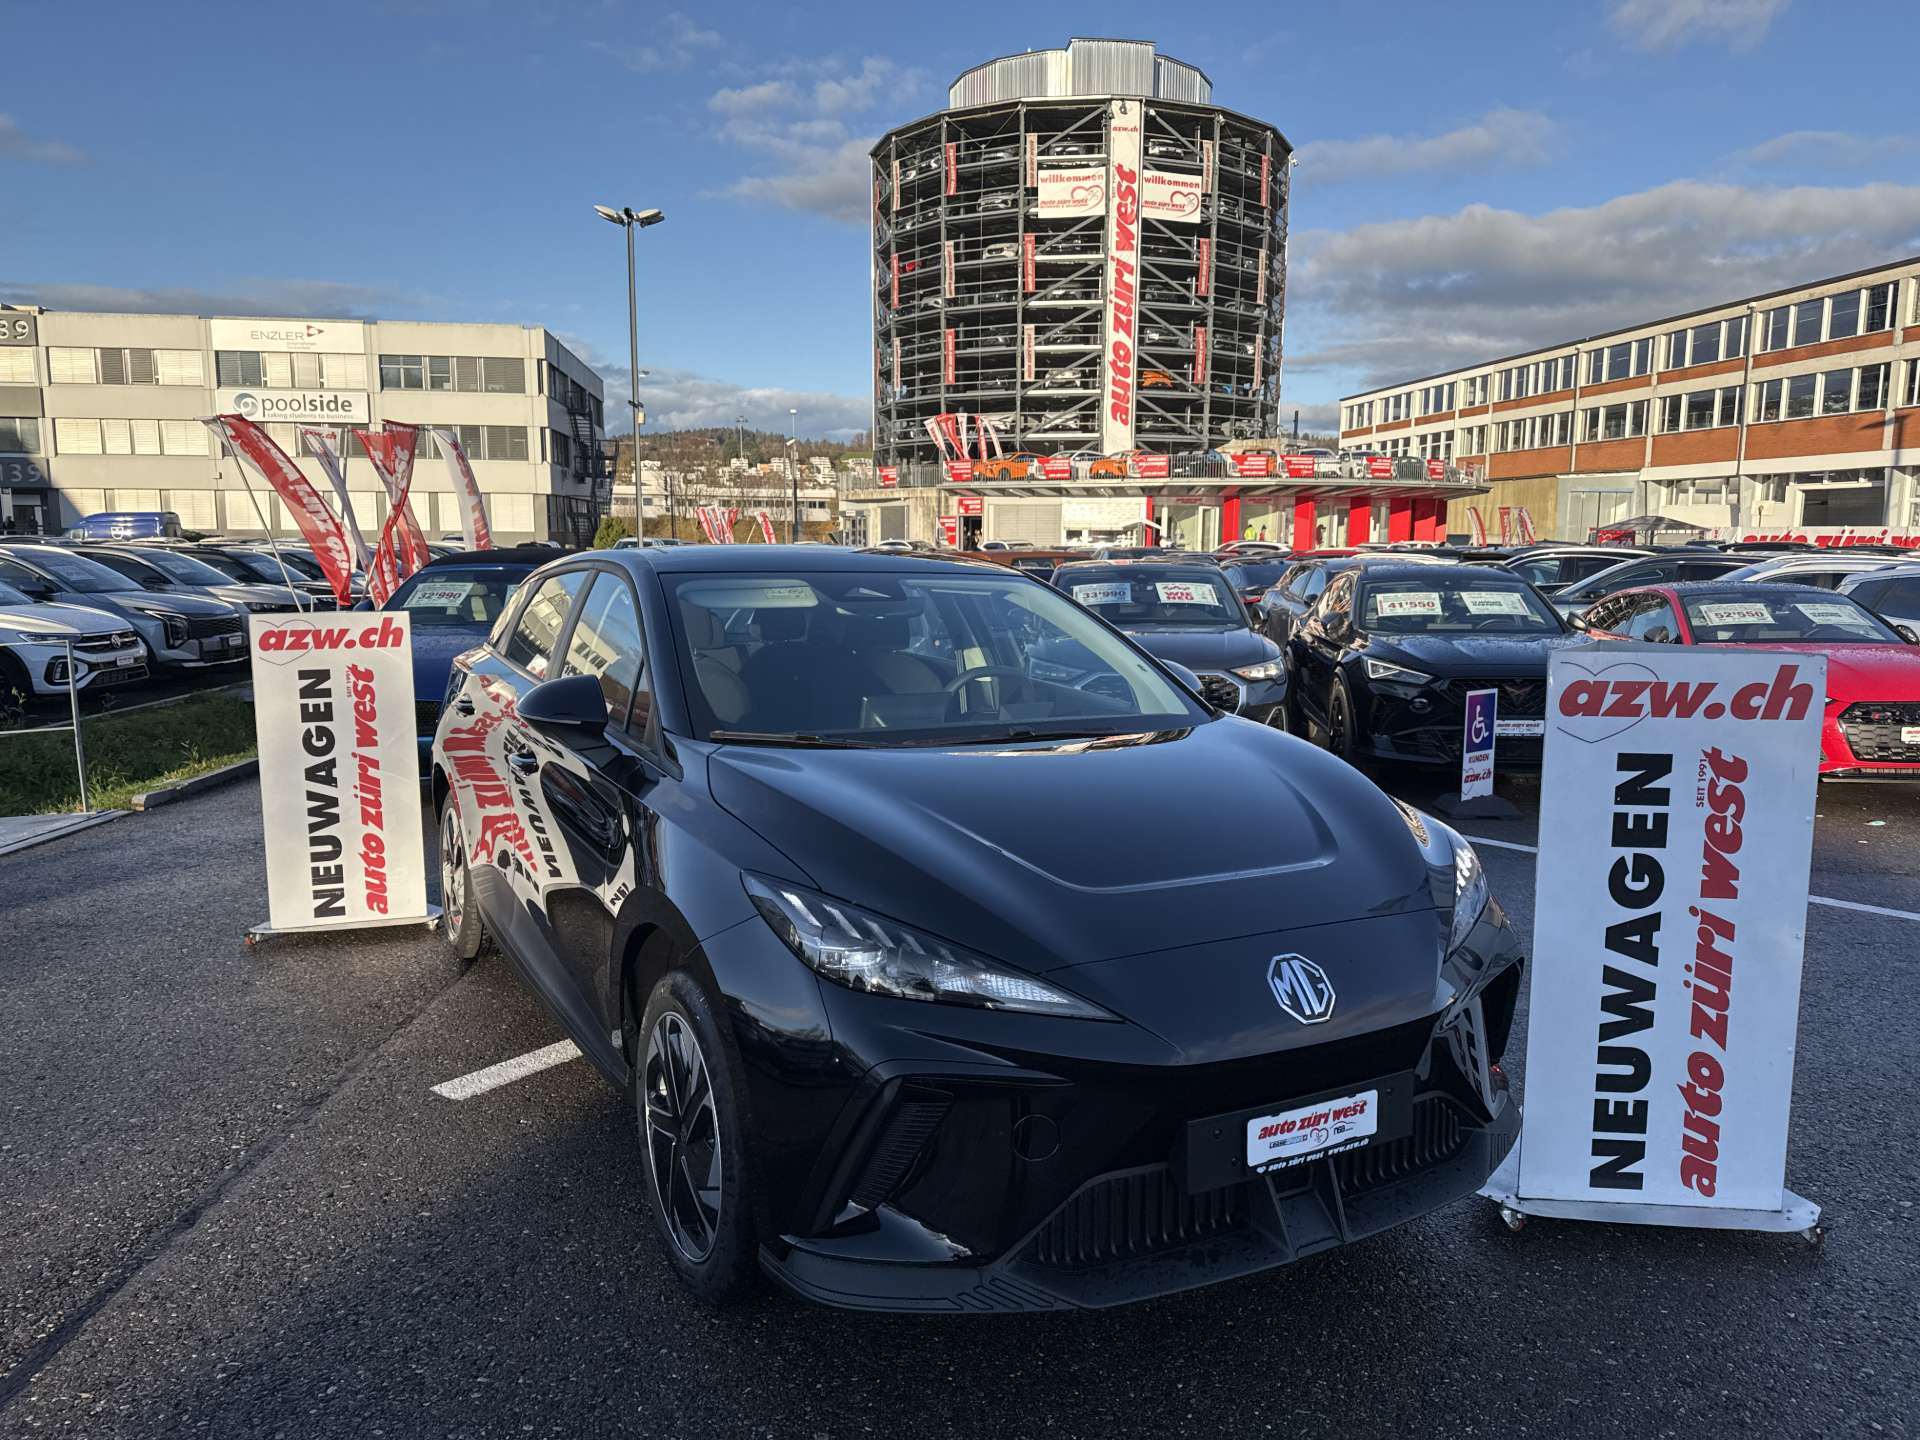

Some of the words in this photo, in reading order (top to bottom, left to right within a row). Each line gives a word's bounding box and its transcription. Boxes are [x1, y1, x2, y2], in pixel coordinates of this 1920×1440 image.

[1040, 173, 1103, 184] willkommen
[1143, 175, 1200, 189] willkommen
[1114, 163, 1137, 251] west
[1109, 256, 1135, 339] züri
[251, 330, 304, 341] ENZLER
[1108, 341, 1132, 426] auto
[261, 394, 353, 418] poolside
[418, 591, 462, 600] 32'990
[1082, 590, 1127, 599] 33'990
[1388, 601, 1436, 609] 41'550
[258, 617, 404, 651] azw.ch
[347, 663, 379, 748] west
[1558, 664, 1814, 721] azw.ch
[1464, 767, 1492, 784] azw.ch
[1468, 753, 1490, 764] KUNDEN
[1698, 759, 1707, 782] 1991
[298, 669, 346, 918] NEUWAGEN
[351, 752, 384, 831] züri
[1696, 787, 1705, 807] SEIT
[1699, 746, 1749, 900] west
[359, 833, 388, 915] auto
[1274, 959, 1330, 1015] MG
[1589, 752, 1673, 1190] NEUWAGEN
[1682, 905, 1736, 1051] züri
[1258, 1119, 1297, 1140] auto
[1297, 1108, 1332, 1131] züri
[1332, 1099, 1368, 1122] west
[1676, 1051, 1725, 1198] auto
[1267, 1161, 1287, 1171] auto
[1306, 1151, 1325, 1162] west
